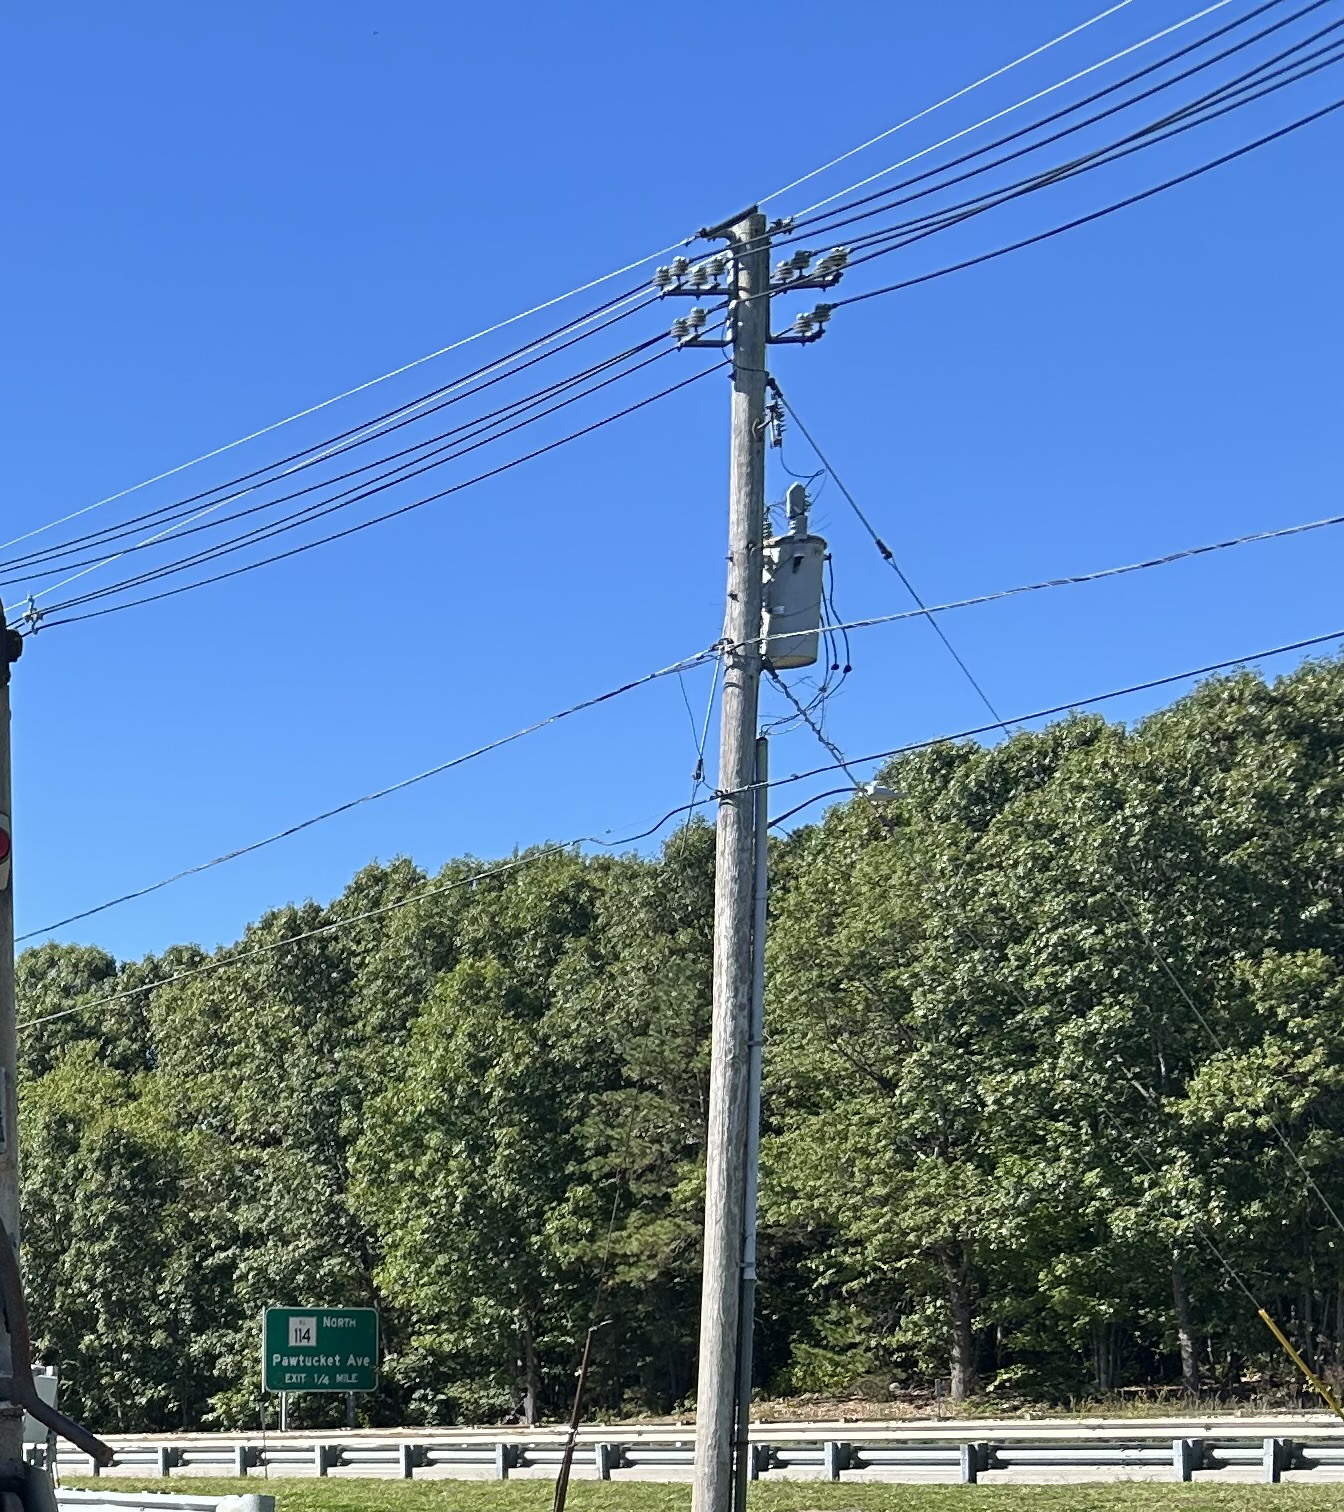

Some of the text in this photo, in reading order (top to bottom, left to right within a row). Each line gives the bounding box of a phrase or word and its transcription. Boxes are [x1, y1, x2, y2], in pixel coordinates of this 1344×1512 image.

[322, 1316, 357, 1328] NORTH
[294, 1327, 311, 1343] 114
[272, 1353, 370, 1367] Pawtucket Ave
[284, 1373, 359, 1385] EXIT 1/4 MILE
